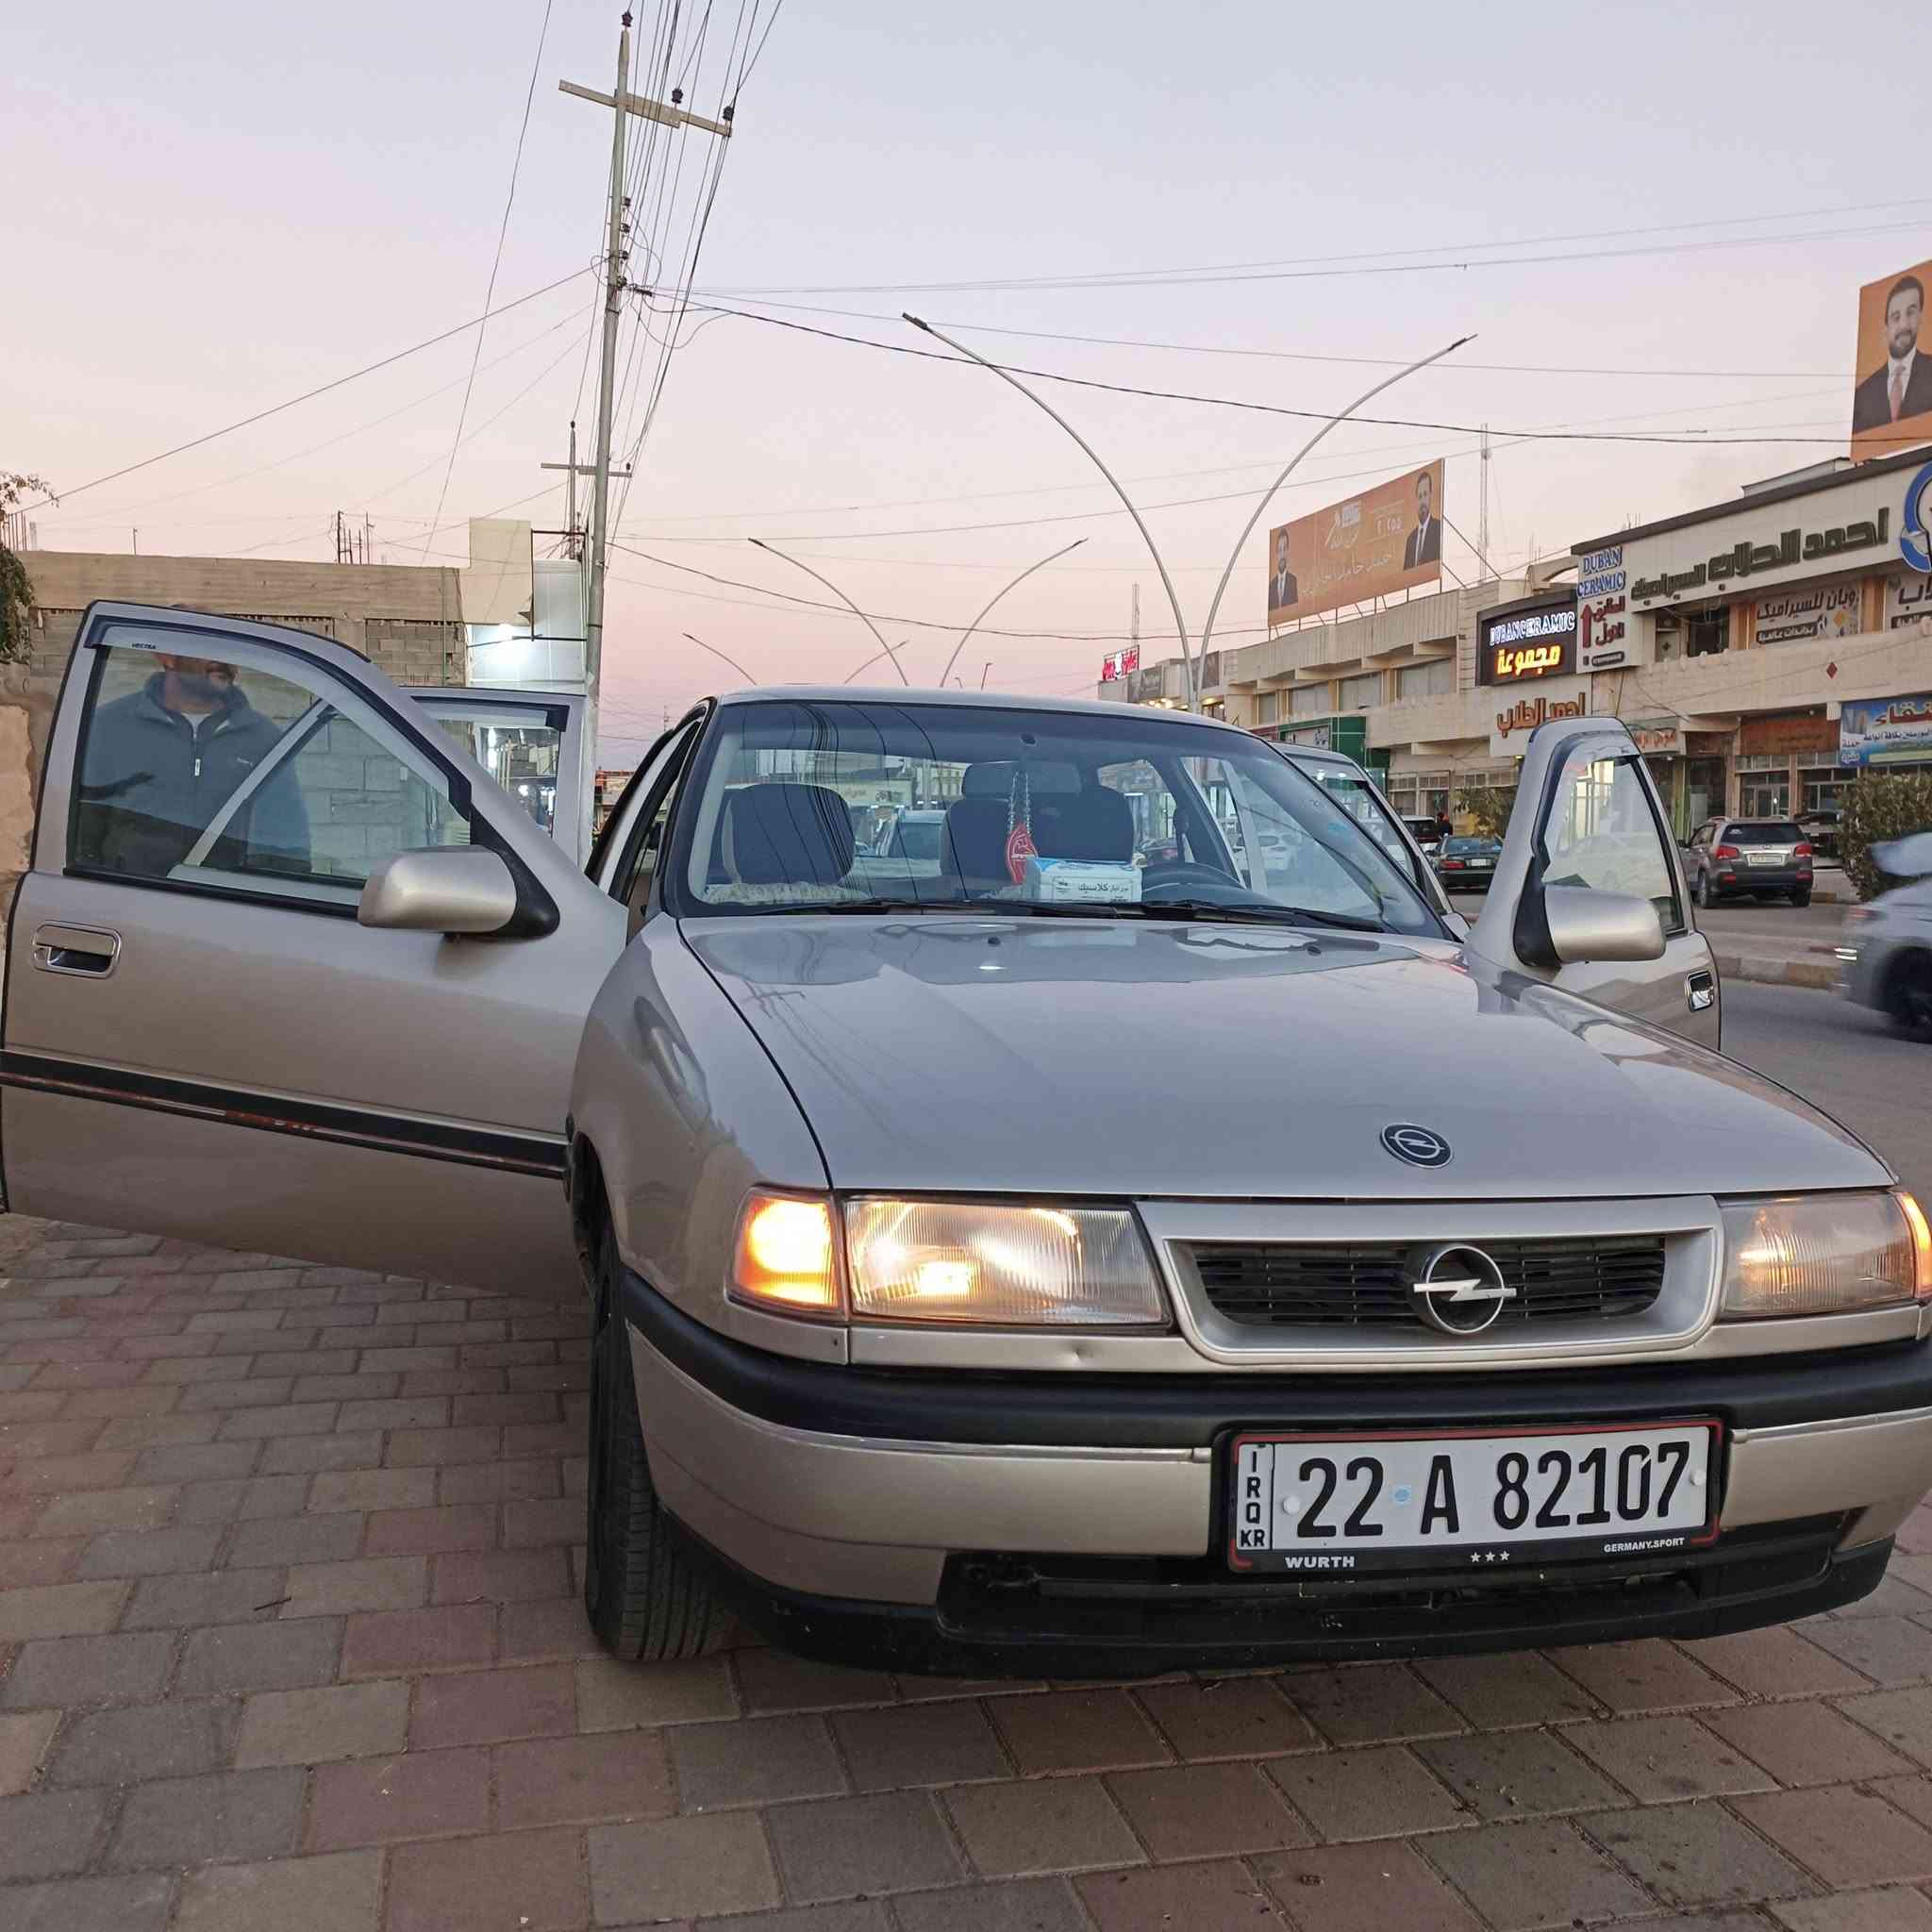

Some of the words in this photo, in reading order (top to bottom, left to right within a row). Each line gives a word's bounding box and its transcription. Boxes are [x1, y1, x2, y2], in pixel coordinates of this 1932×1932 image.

[1583, 545, 1623, 575] DUBAN
[1577, 571, 1626, 600] CERAMIC
[1757, 591, 1824, 623] للسيراميك
[1497, 645, 1560, 675] مجموعة
[1296, 1457, 1385, 1539] 22
[1419, 1455, 1460, 1535] A
[1492, 1441, 1691, 1530] 82107
[1241, 1529, 1265, 1548] KR
[1285, 1556, 1356, 1569] WURTH
